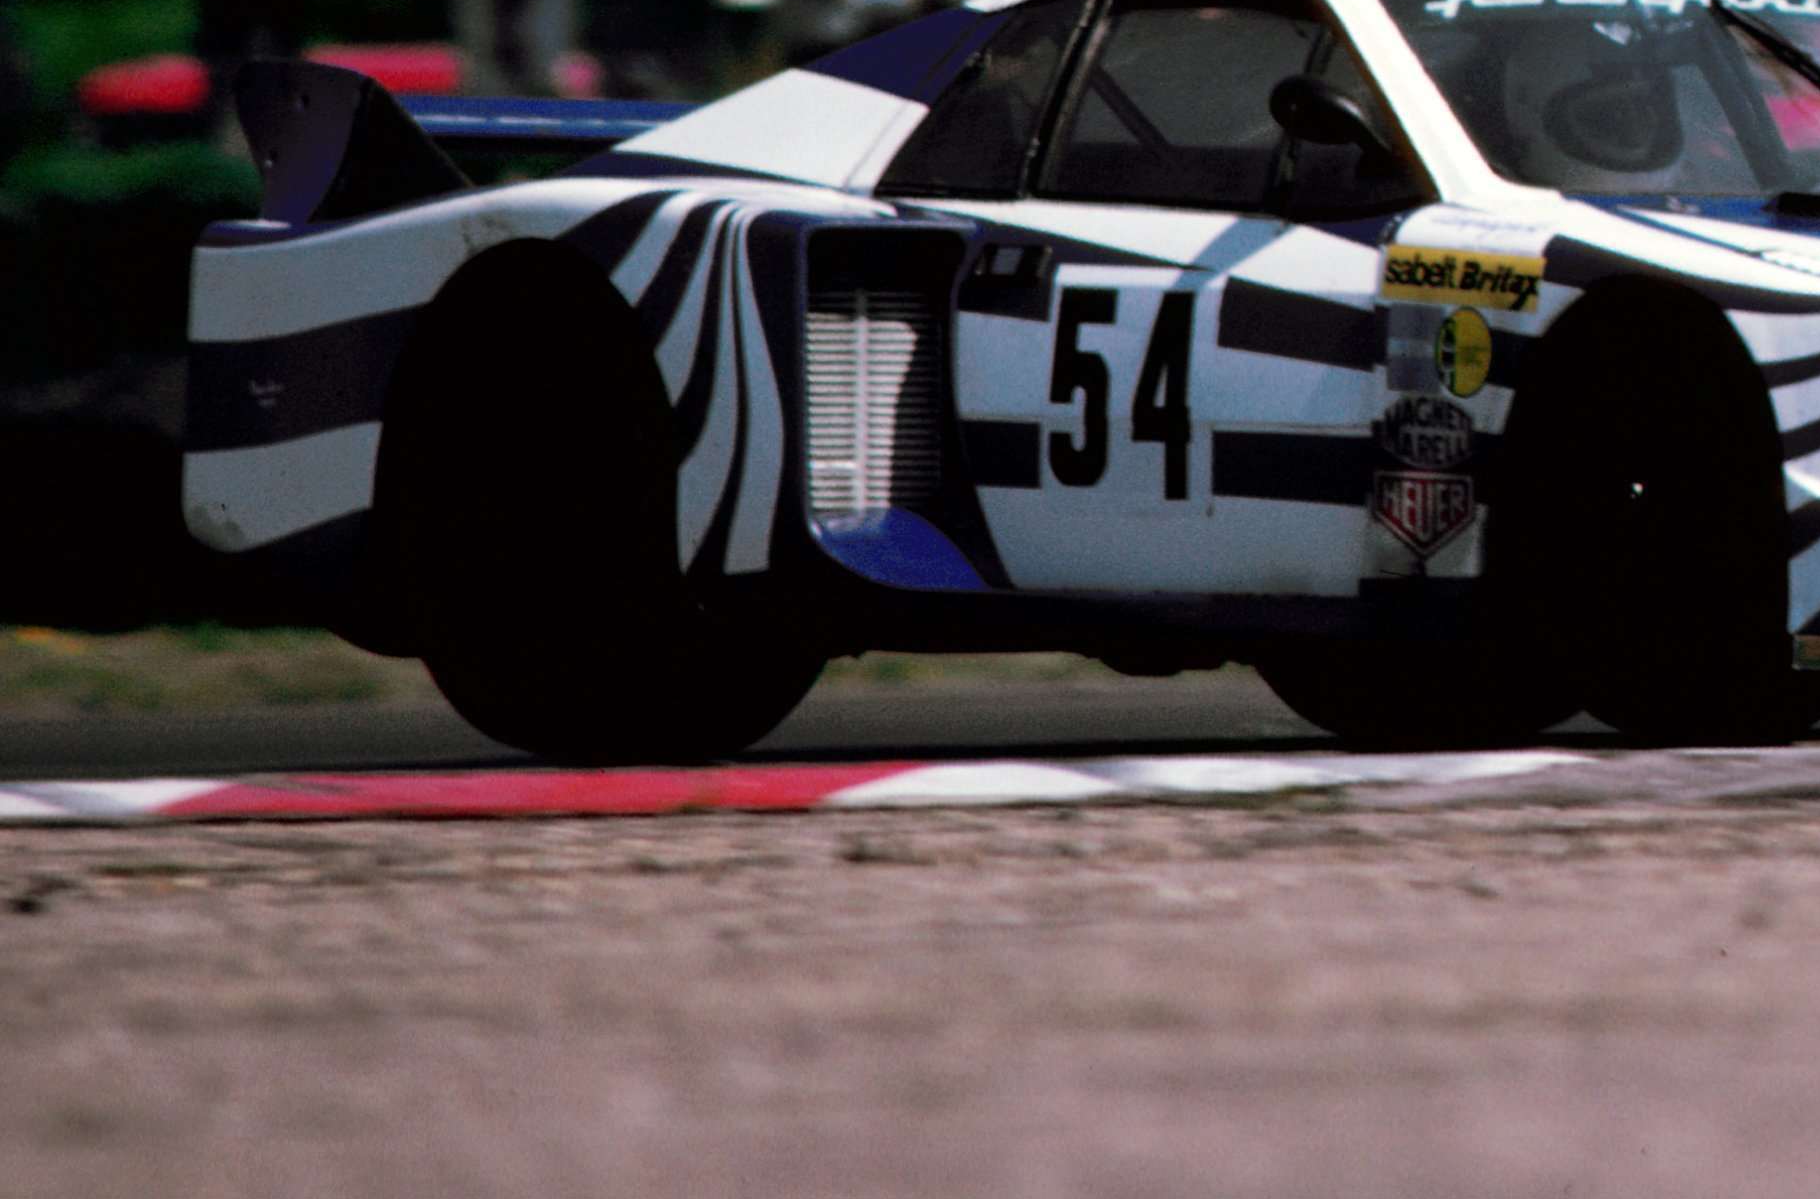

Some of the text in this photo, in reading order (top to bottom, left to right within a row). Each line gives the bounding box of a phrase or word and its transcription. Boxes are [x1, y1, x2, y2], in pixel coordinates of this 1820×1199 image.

[1459, 260, 1541, 312] Britax
[1048, 285, 1196, 501] 54
[1382, 479, 1467, 542] HEUER
